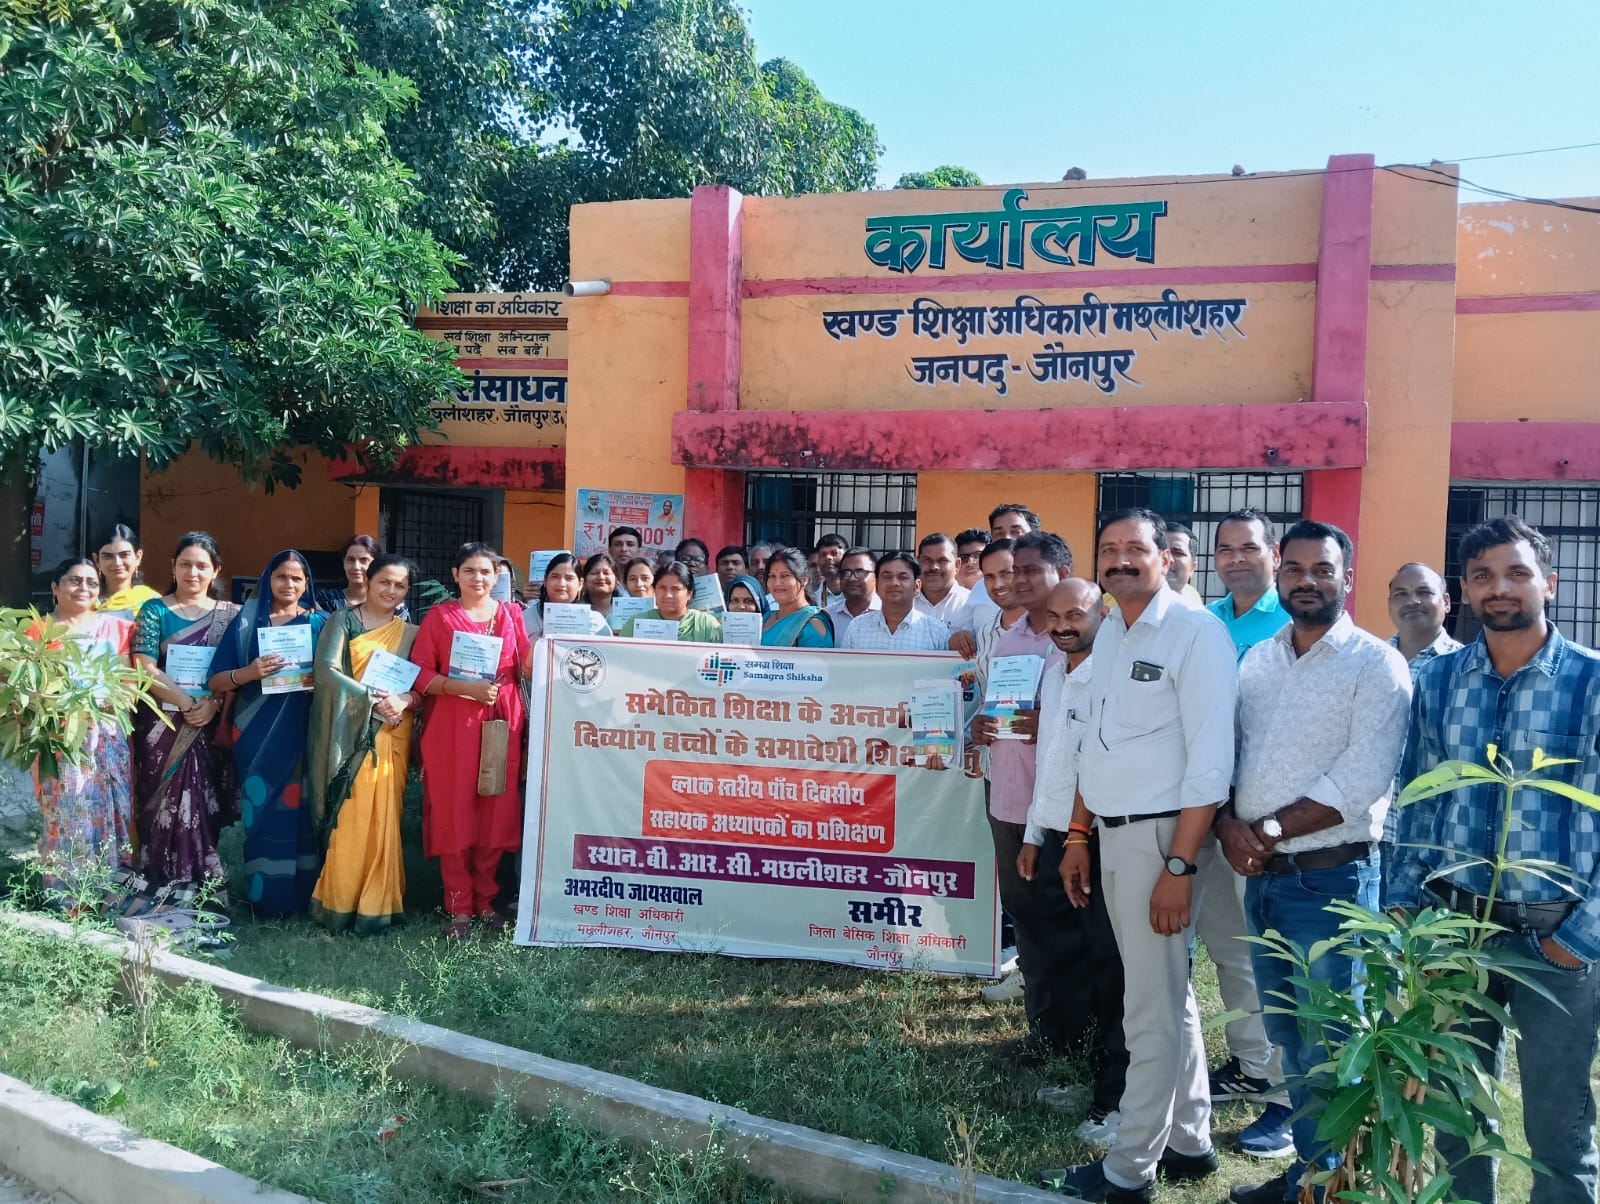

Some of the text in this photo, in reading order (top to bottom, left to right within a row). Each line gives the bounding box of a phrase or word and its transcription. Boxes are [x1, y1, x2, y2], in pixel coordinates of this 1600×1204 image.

[864, 188, 1168, 273] कार्यालय
[475, 301, 496, 315] का
[498, 295, 563, 316] अधिकार
[822, 288, 1247, 345] खण्ड शिक्षा अधिकारी मछलीशहर
[465, 331, 491, 343] शिक्षा
[498, 345, 518, 355] सब
[904, 354, 1009, 395] जनपद
[1026, 342, 1142, 393] जौनपुर
[743, 671, 823, 682] Samagra Shiksha
[745, 659, 794, 670] समग्र शिक्षा
[625, 688, 717, 718] समेकित
[723, 692, 791, 722] शिक्षा
[797, 696, 823, 724] के
[829, 701, 912, 728] अन्तर्ग
[574, 720, 656, 752] दिव्यांग
[663, 728, 722, 756] बच्चों
[724, 730, 749, 757] के
[755, 734, 858, 764] समावेशी
[671, 774, 865, 806] ब्लाक स्तरीय पाँच दिवसीय
[650, 809, 886, 844] सहायक अध्यापकों का प्रशिक्षण
[564, 876, 703, 906] अमरदीप जायसवाल
[573, 903, 684, 922] खण्ड शिक्षा अधिकारी
[848, 897, 922, 927] समीर
[641, 924, 679, 944] जौनपुर
[809, 924, 967, 950] जिला बेसिक शिक्षा अधिकारी
[866, 945, 904, 966] जौनपुर
